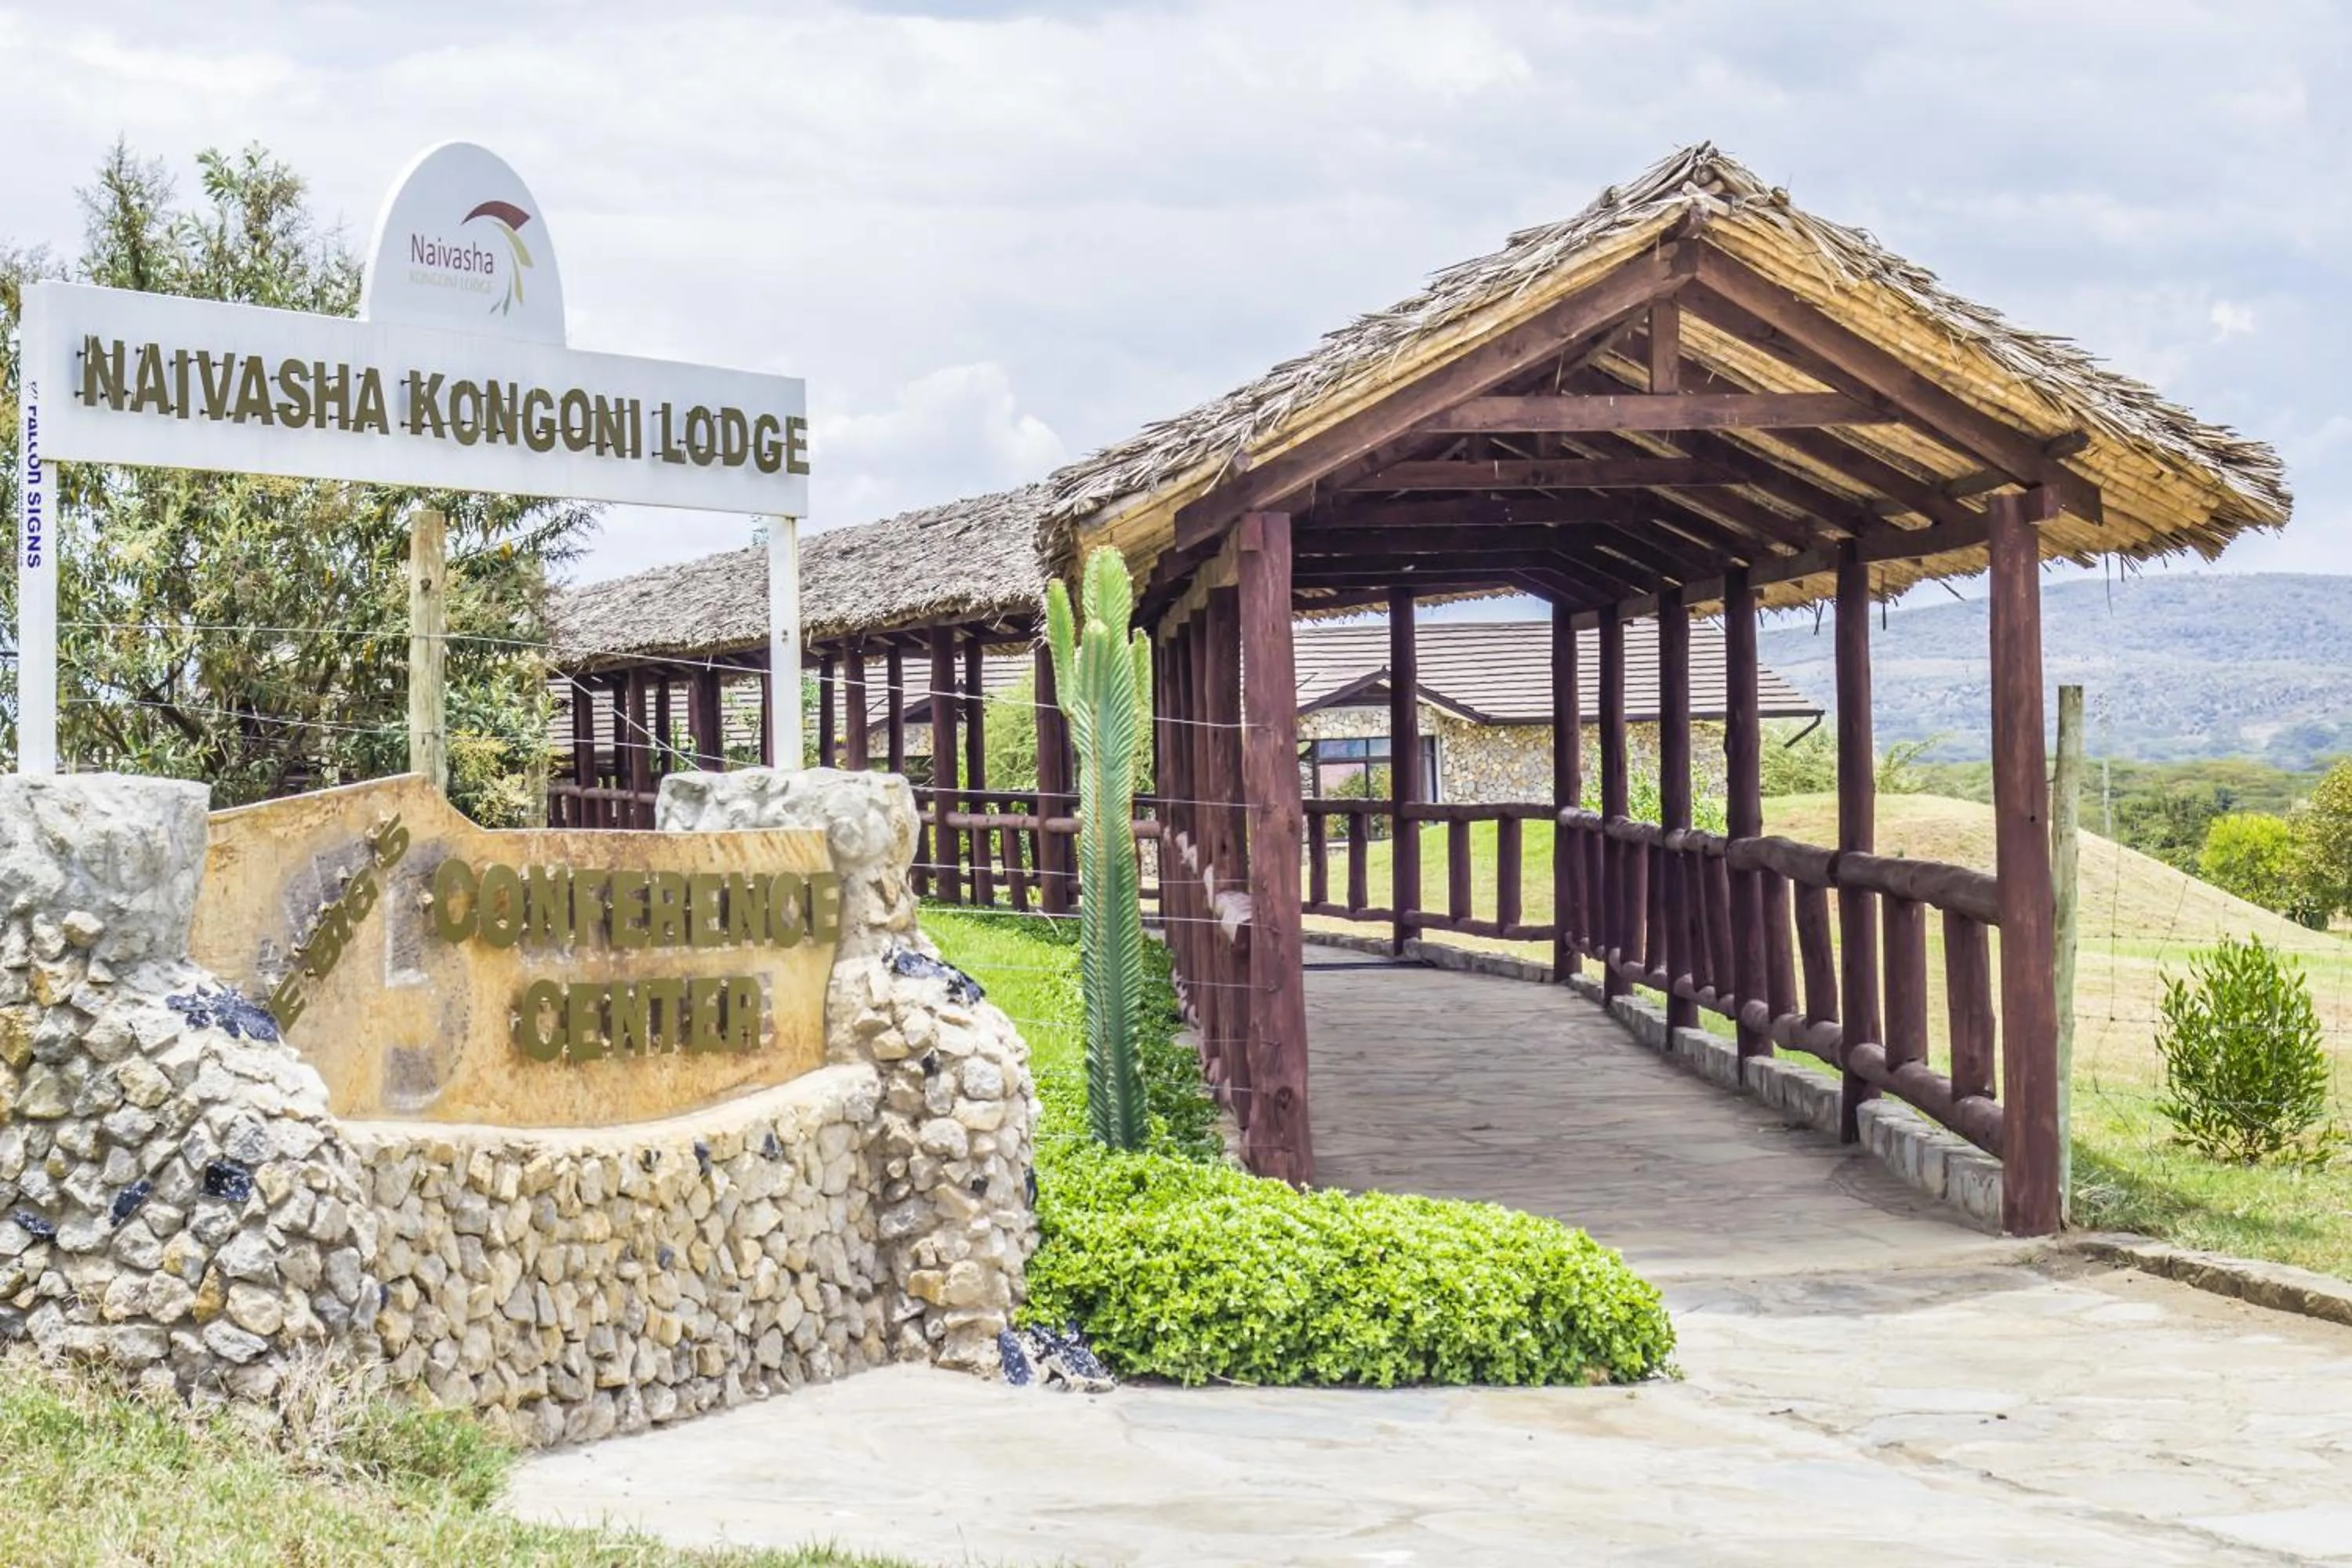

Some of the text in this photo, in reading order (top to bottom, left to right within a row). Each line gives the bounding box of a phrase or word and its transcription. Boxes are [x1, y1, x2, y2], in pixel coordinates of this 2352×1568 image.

[412, 233, 494, 274] Naivasha
[83, 334, 810, 475] NAIVASHA KONGONI LODGE
[27, 492, 42, 568] SIGNS
[434, 858, 841, 949] CONFERENCE
[523, 978, 761, 1062] CENTER
